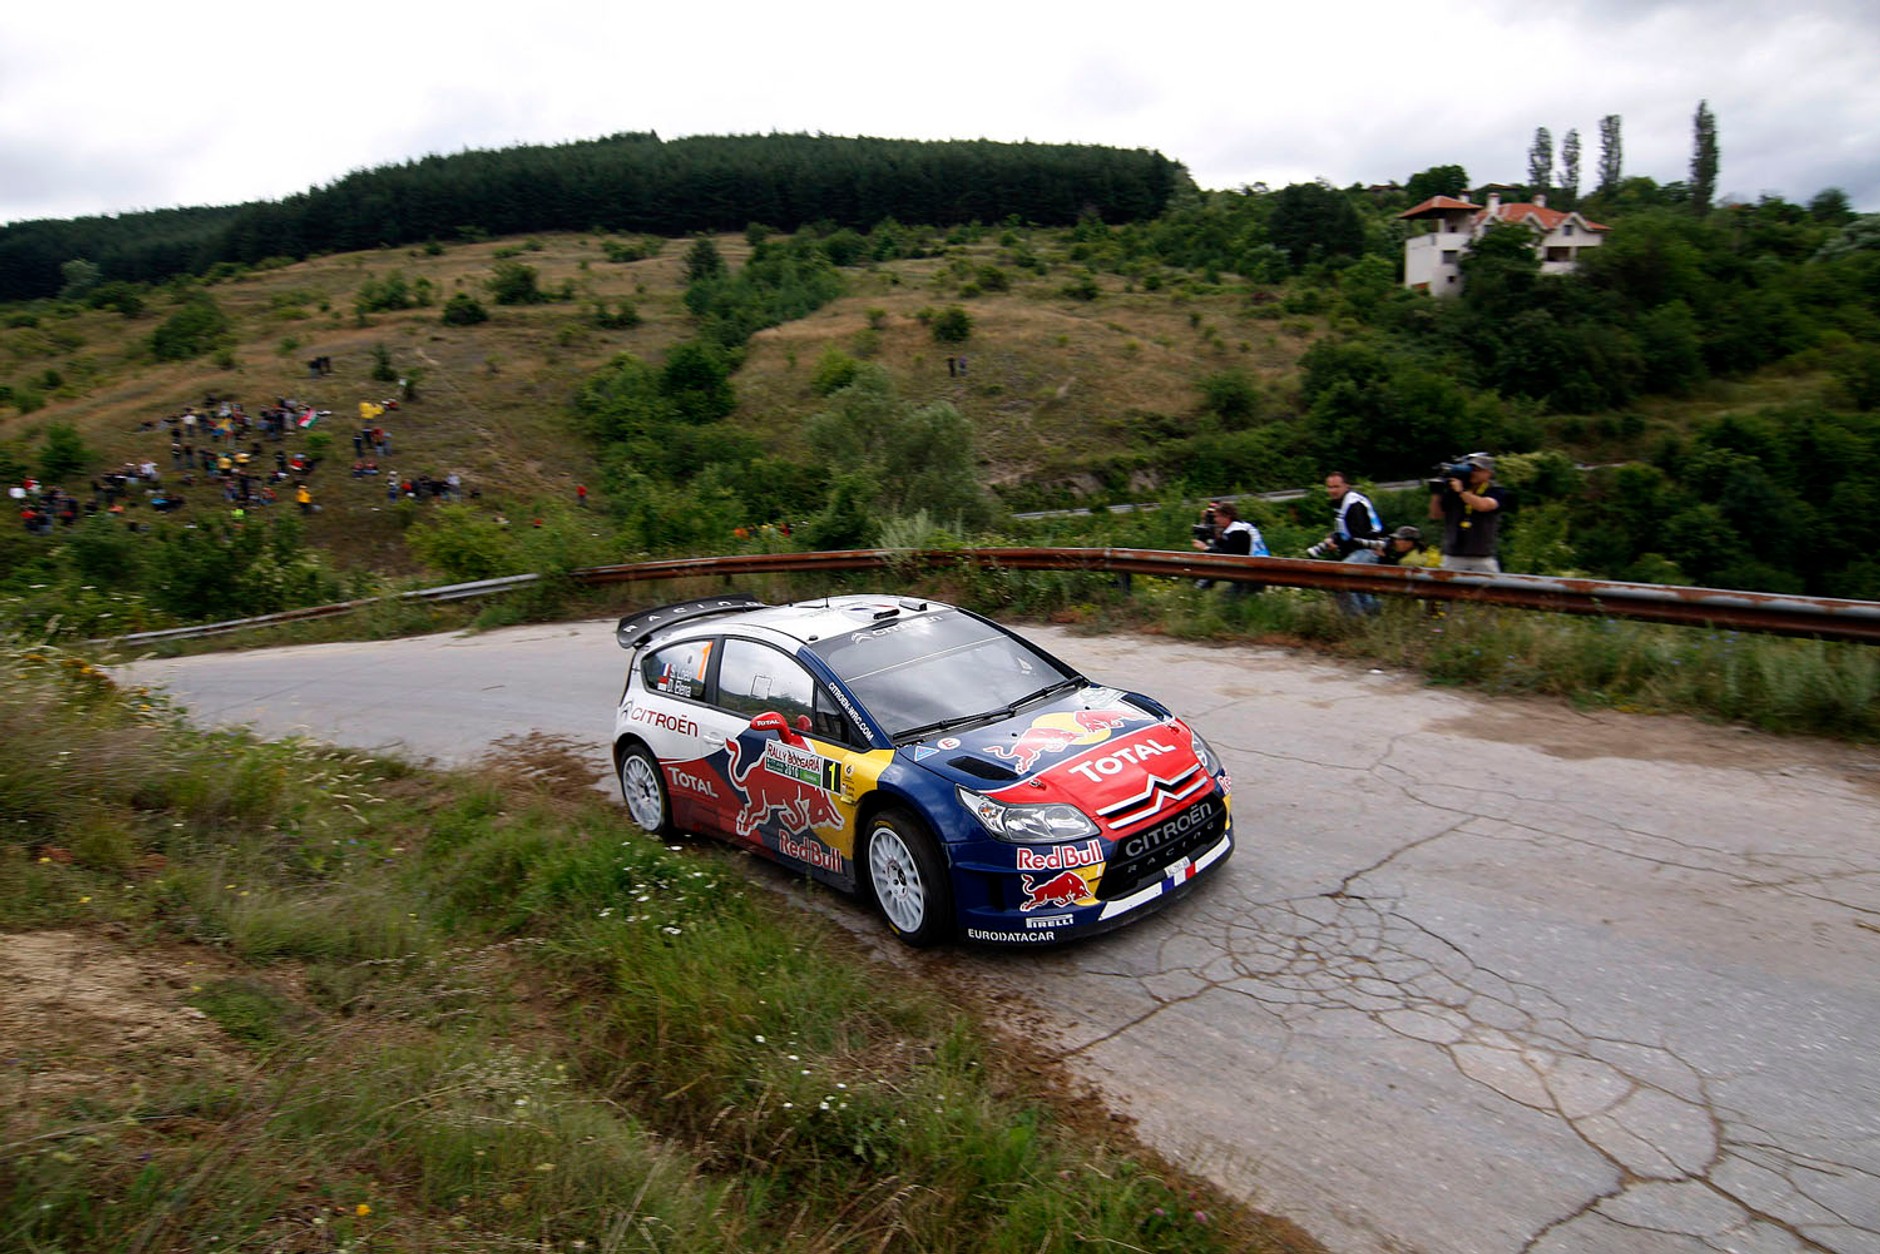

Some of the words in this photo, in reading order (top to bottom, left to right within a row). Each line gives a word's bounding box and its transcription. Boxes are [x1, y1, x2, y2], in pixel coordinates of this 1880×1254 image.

[675, 680, 692, 698] Elena
[756, 719, 780, 727] TOTAL
[828, 682, 875, 741] CITROEN-WRC.COM
[767, 743, 788, 762] RALLY
[1067, 739, 1177, 783] TOTAL
[784, 763, 799, 778] 2010
[828, 762, 836, 791] 1
[667, 767, 720, 799] TOTAL
[778, 827, 812, 862] Red
[811, 838, 844, 874] Bull
[1016, 845, 1062, 871] Red
[1061, 838, 1104, 869] Bull
[1026, 913, 1075, 929] PIRELLI
[968, 928, 1055, 942] EURODATACAR
